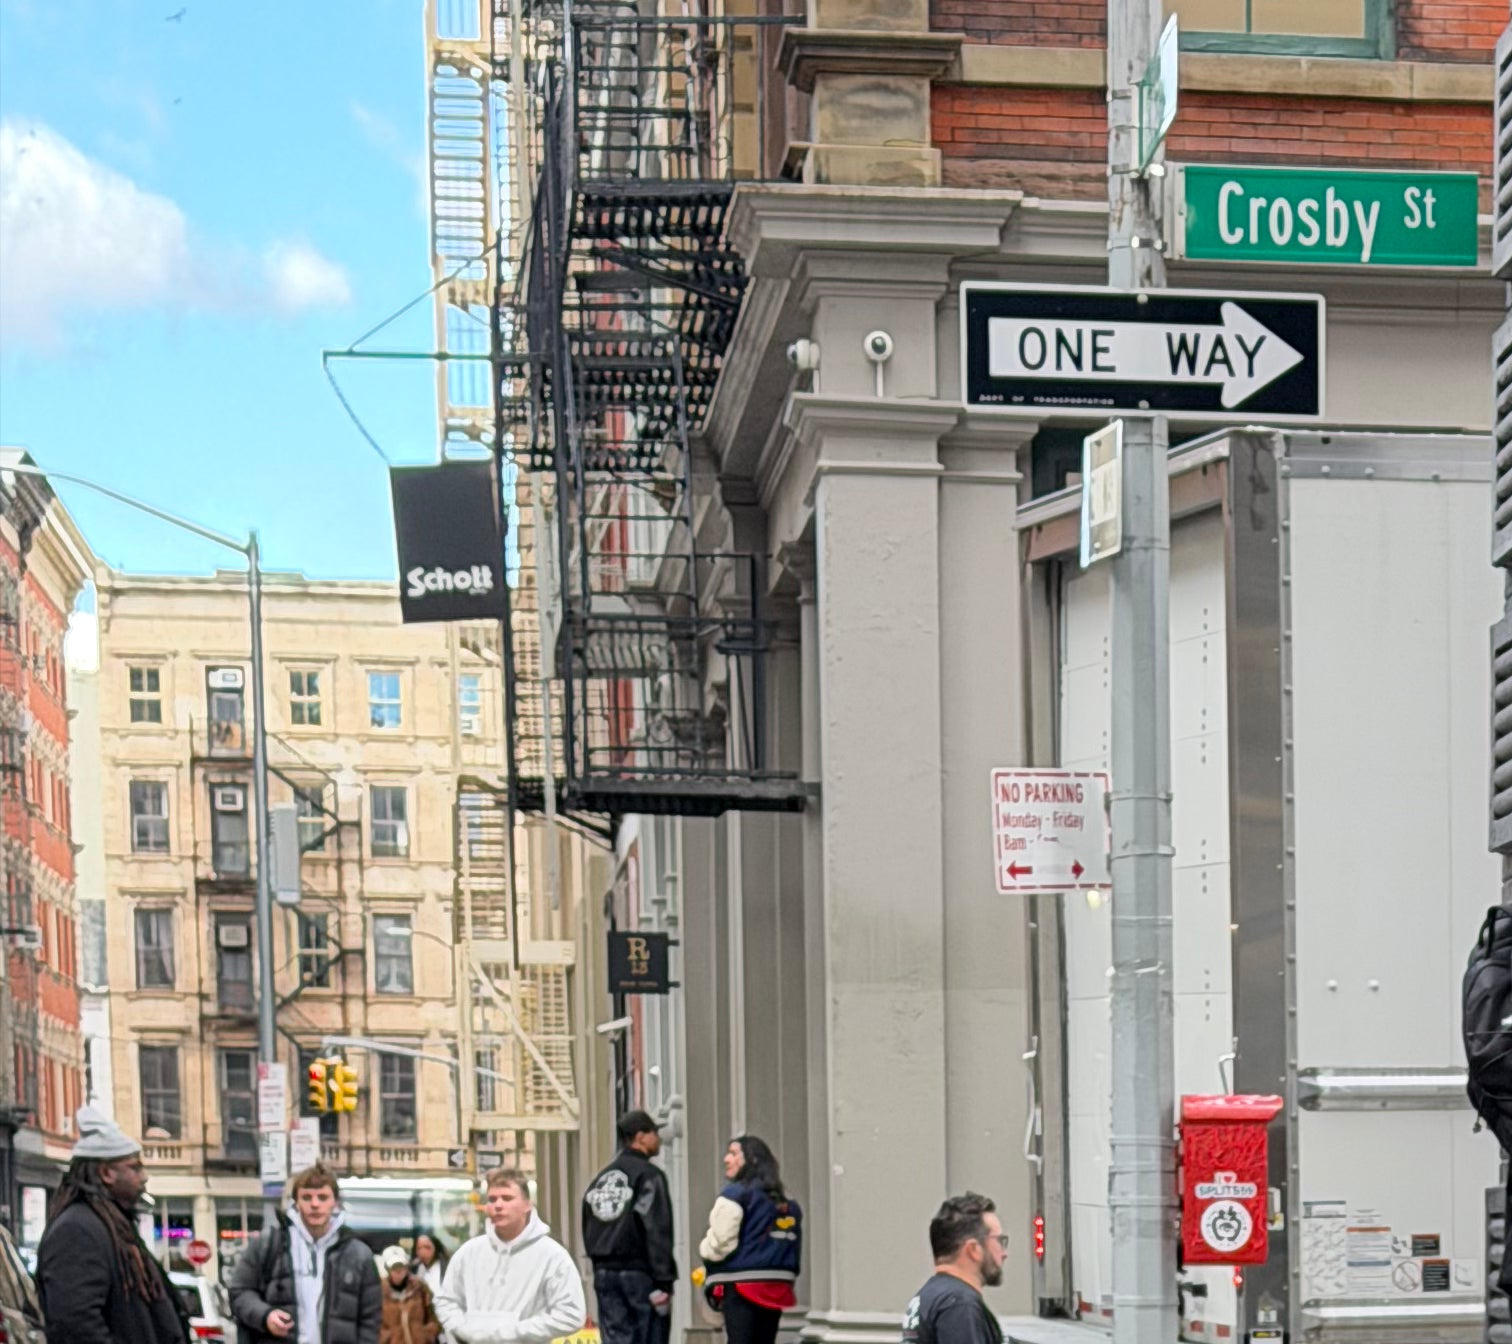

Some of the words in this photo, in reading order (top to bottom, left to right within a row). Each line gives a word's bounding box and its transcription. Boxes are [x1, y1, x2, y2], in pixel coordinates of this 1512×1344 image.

[1218, 180, 1381, 263] Crosby
[1403, 186, 1437, 229] St
[1018, 326, 1117, 372] ONE
[1166, 331, 1267, 378] WAY
[1000, 783, 1021, 803] NO
[1024, 783, 1084, 803] PARKING
[626, 937, 650, 960] R
